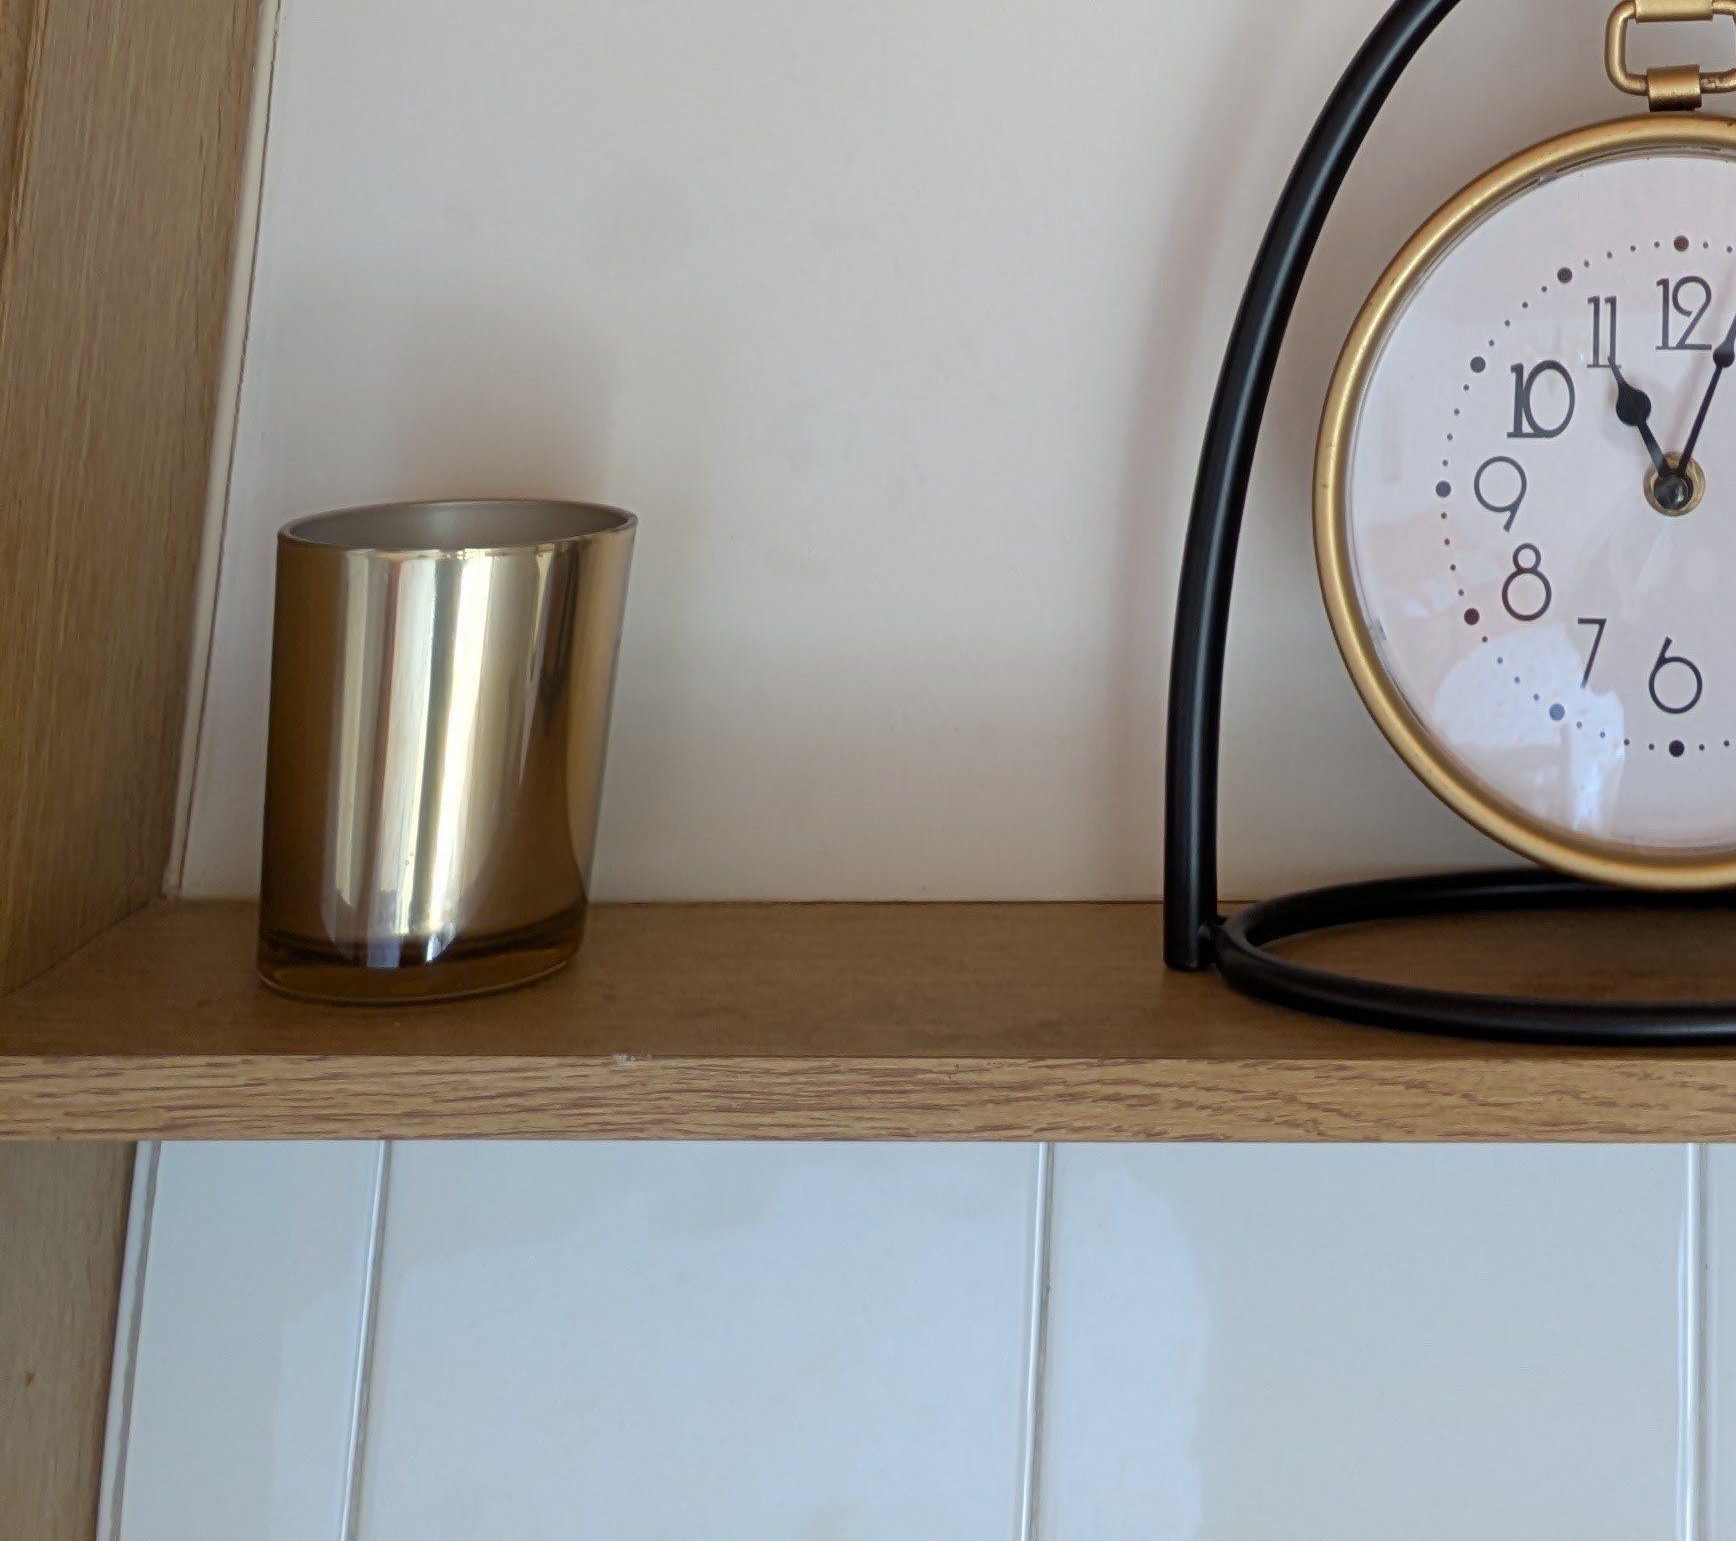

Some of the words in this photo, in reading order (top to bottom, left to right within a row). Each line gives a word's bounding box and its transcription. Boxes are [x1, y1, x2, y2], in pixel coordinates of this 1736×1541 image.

[1586, 296, 1621, 369] 11
[1655, 276, 1713, 351] 12
[1506, 360, 1576, 438] 10
[1473, 456, 1528, 532] 9
[1501, 543, 1552, 621] 8
[1577, 617, 1606, 688] 7
[1648, 636, 1703, 714] 6
